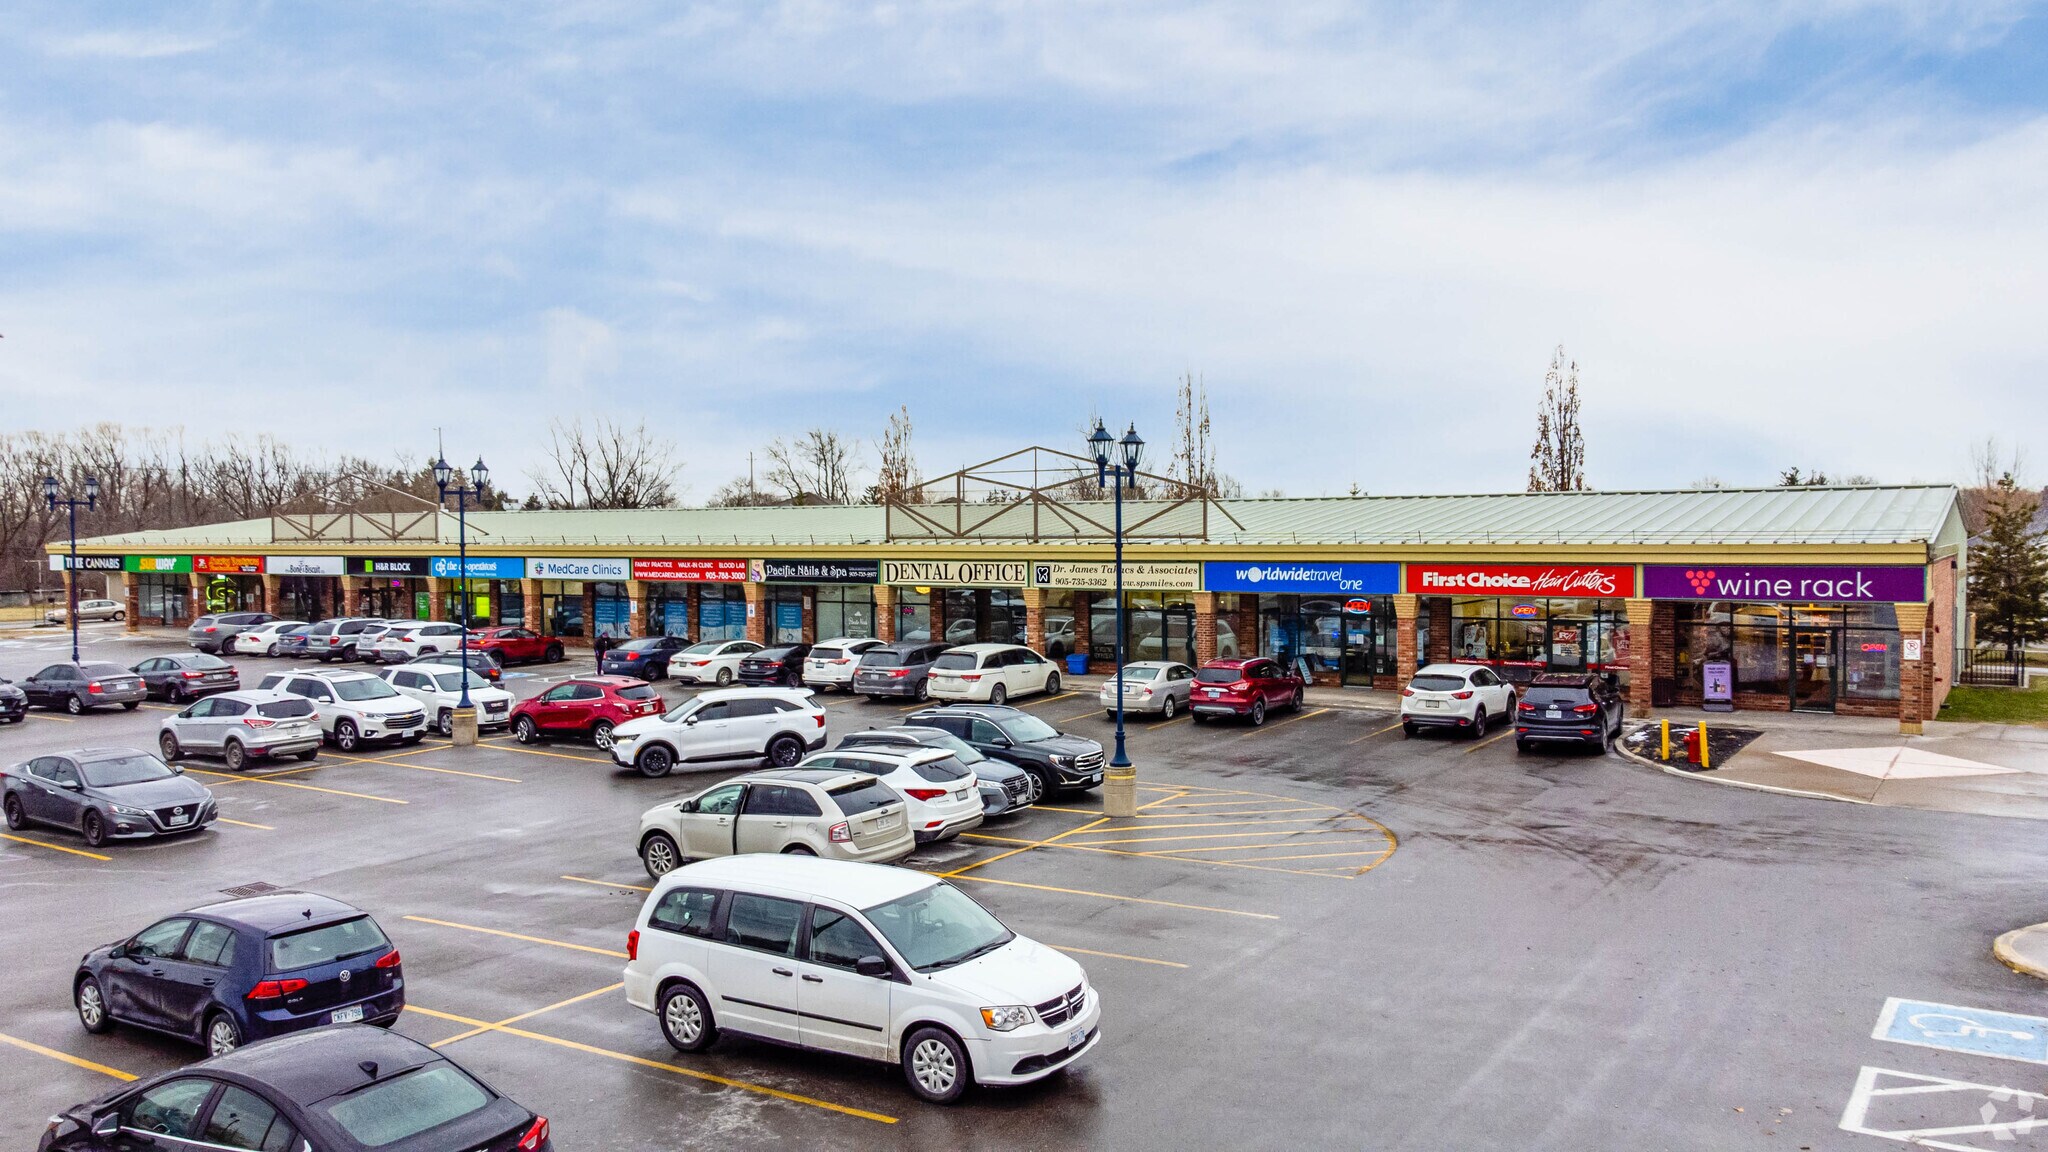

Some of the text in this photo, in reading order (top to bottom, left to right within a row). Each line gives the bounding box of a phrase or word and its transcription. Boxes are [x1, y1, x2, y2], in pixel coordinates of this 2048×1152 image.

[85, 558, 120, 570] CANNABIS
[140, 557, 177, 570] SUBWAY
[375, 562, 411, 571] H&R BLOCK
[446, 561, 497, 572] the c-operators
[547, 563, 622, 575] MedCare Clinics
[766, 564, 847, 579] Pacific Nails & Spa
[885, 563, 1026, 584] DENTAL OFFICE
[1052, 564, 1067, 573] Dr.
[1069, 564, 1099, 574] James
[1136, 564, 1145, 575] &
[1147, 565, 1198, 575] Associates
[634, 571, 746, 580] WWW.MEDCARECLINICS.COM 905-788-3000
[1055, 577, 1108, 587] 905-735-3362
[1339, 578, 1363, 591] one
[1422, 568, 1616, 595] First Choice Hair Cutters
[1717, 571, 1874, 598] wine rack
[1345, 601, 1371, 611] OPEN
[1513, 607, 1537, 615] OPEN
[1860, 643, 1888, 652] OPEN
